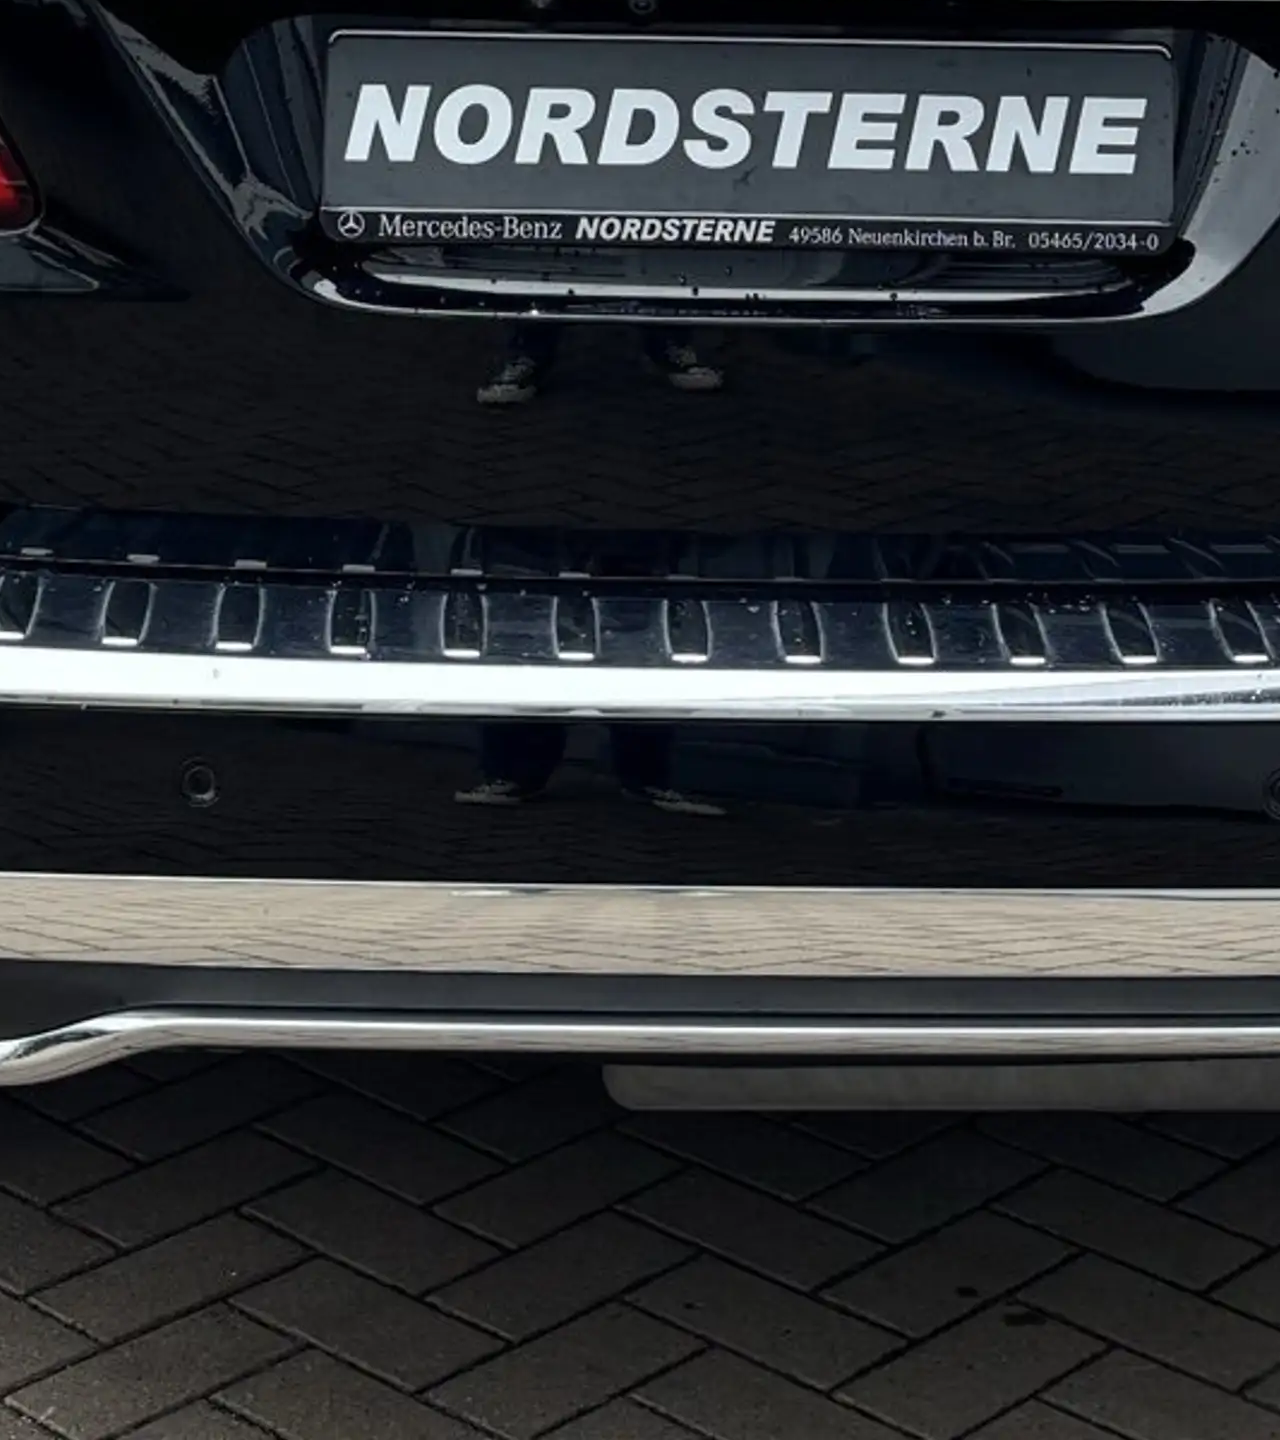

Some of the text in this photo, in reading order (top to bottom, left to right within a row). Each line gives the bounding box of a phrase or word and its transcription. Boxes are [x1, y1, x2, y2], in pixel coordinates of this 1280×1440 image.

[344, 84, 1147, 174] NORDSTERNE
[378, 215, 1159, 251] Mercedes-Benz NORDSTERNE 49586 Neuenkirchen b. Br. 05465/2034-0
